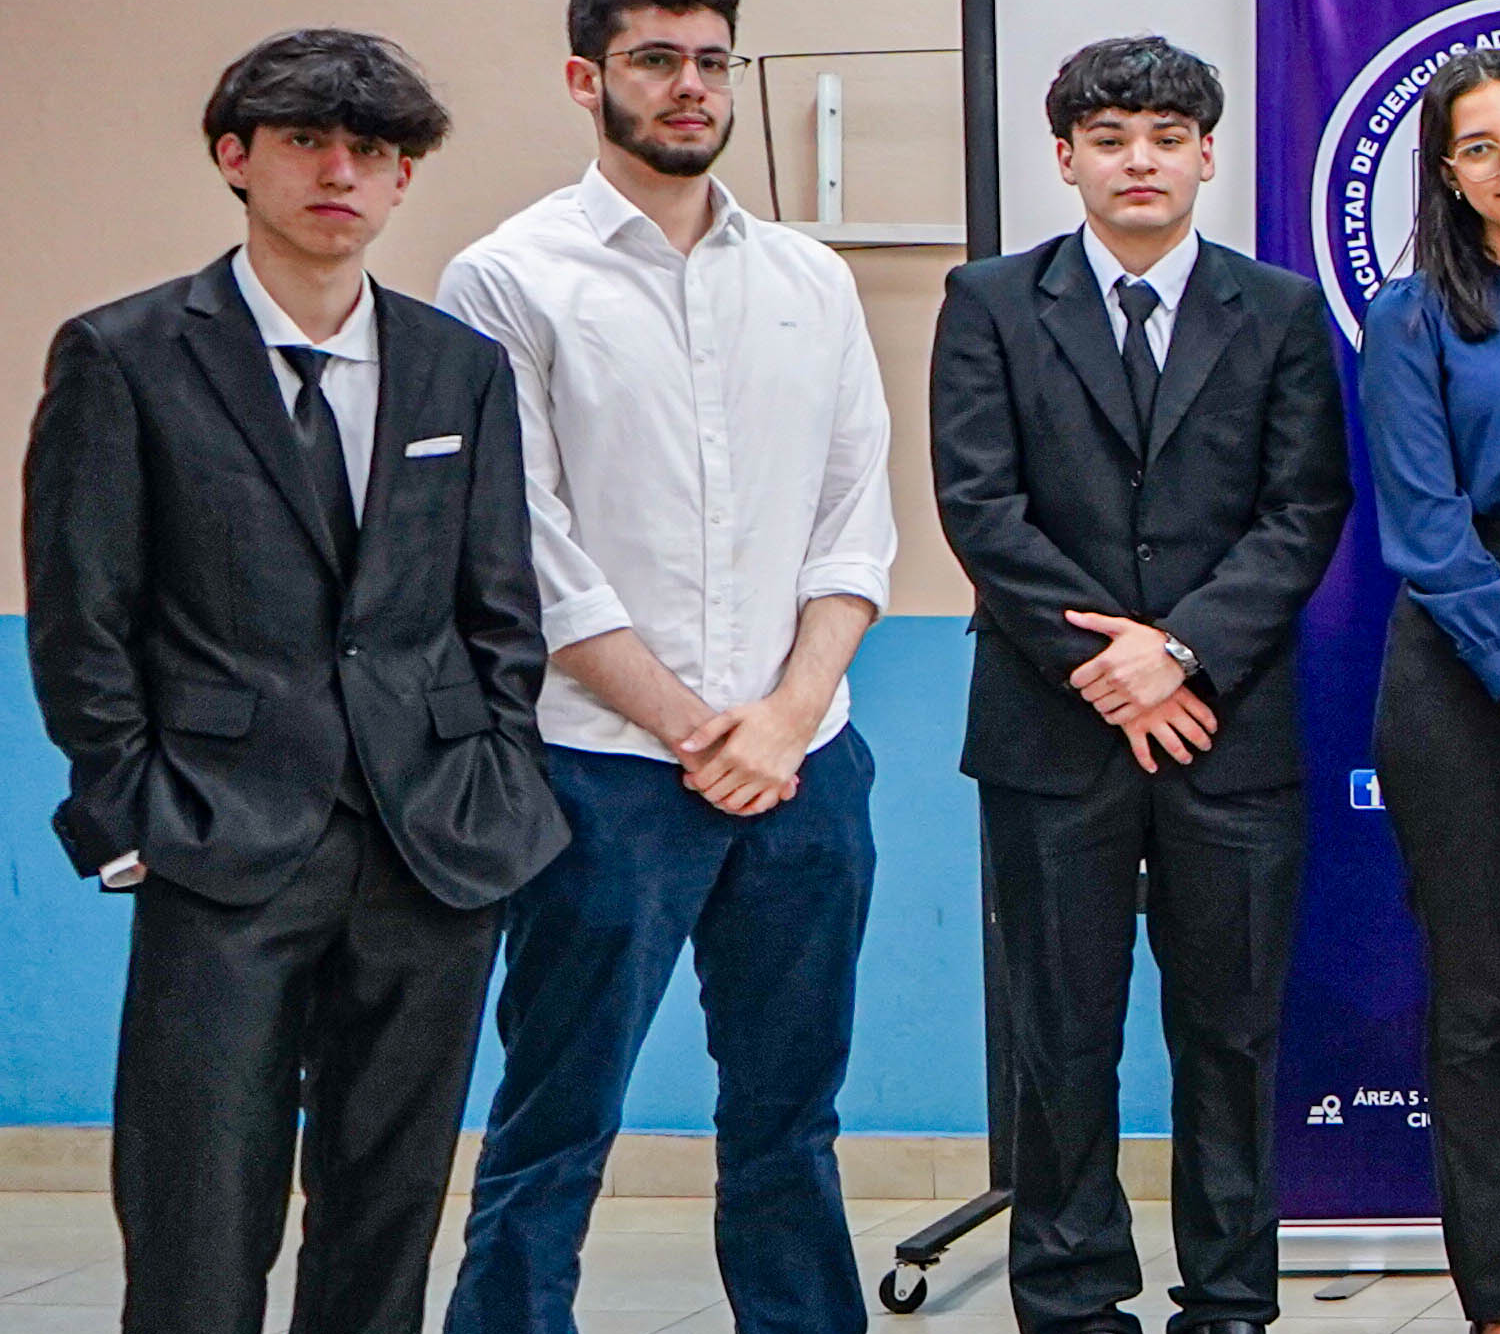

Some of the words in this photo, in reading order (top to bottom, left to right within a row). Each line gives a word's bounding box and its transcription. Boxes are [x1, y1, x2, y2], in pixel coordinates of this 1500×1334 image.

[1350, 137, 1379, 174] DE
[1352, 1086, 1405, 1106] ÁREA
[1408, 1090, 1419, 1106] 5
